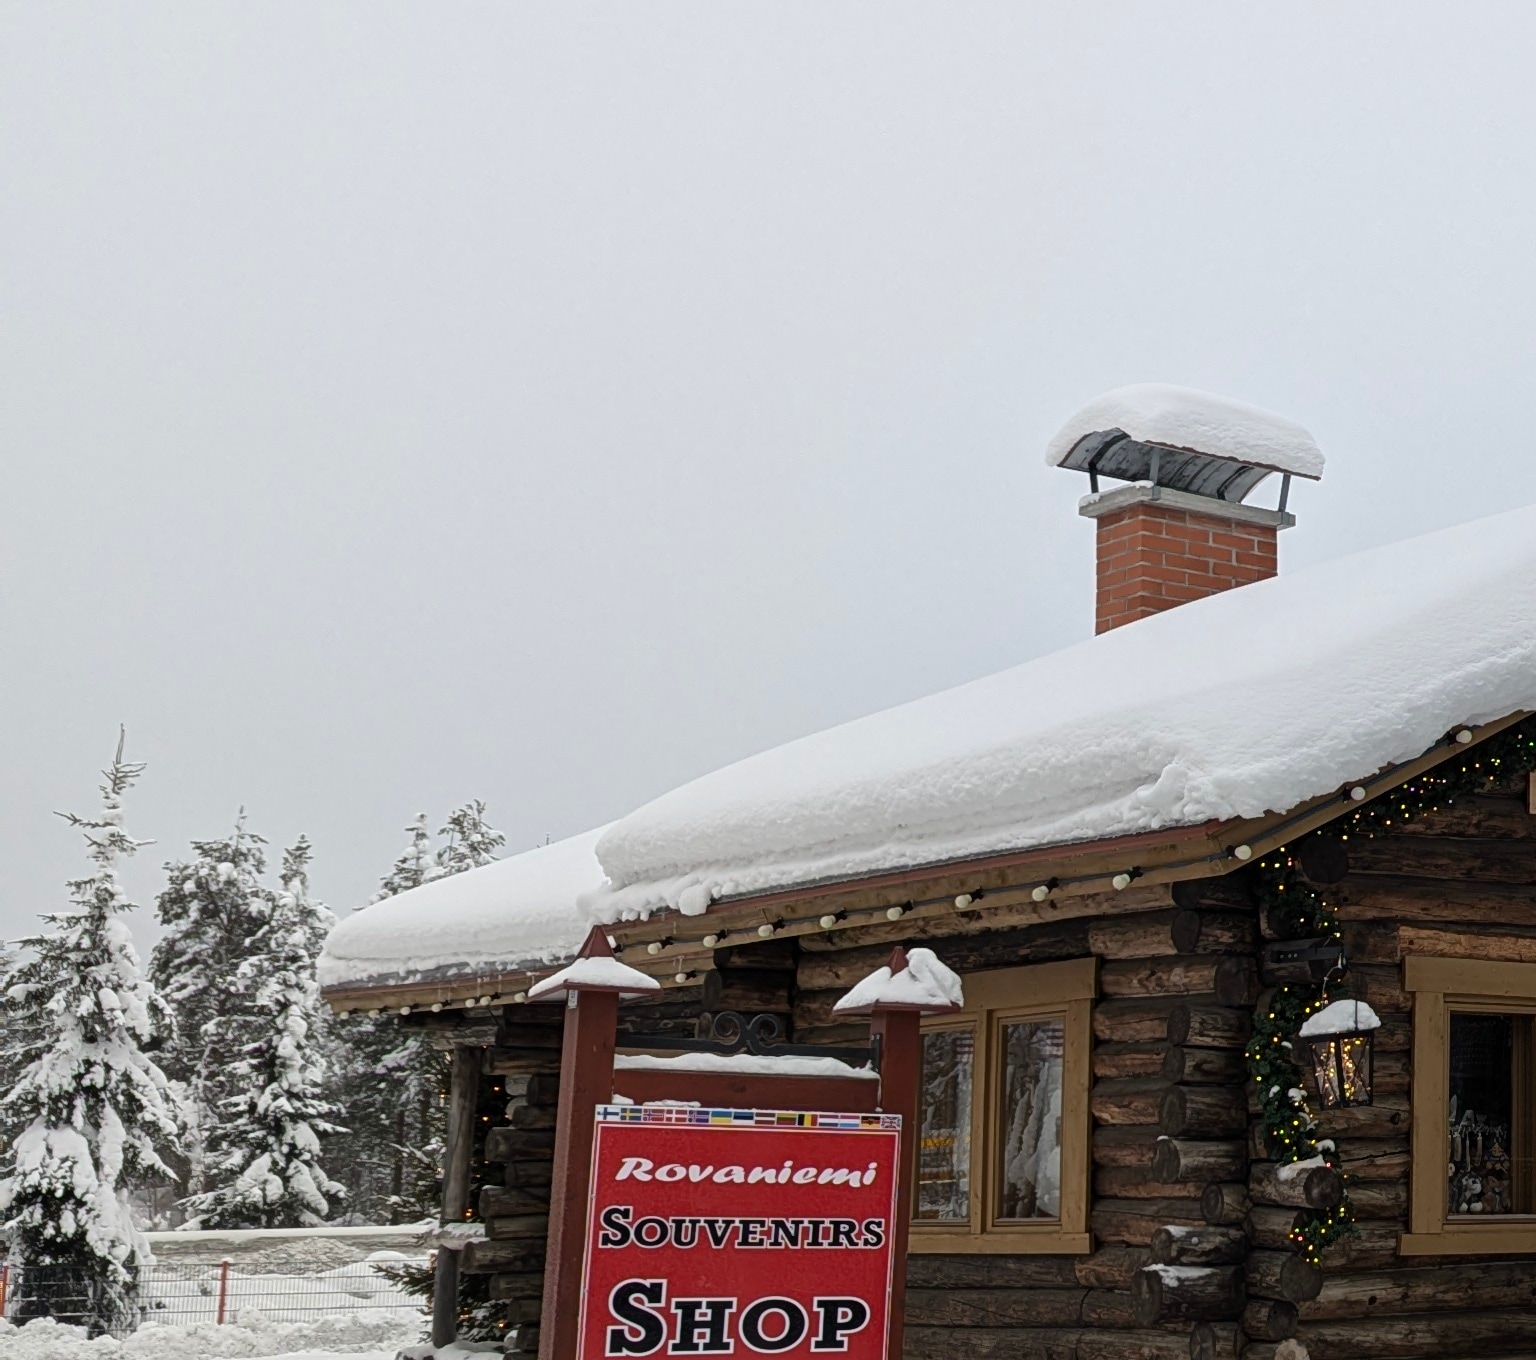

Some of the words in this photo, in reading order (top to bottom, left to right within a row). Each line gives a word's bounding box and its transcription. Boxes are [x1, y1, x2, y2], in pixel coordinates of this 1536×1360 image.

[614, 1157, 878, 1188] Rovaniemi
[598, 1205, 886, 1249] SOUVENIRS
[604, 1278, 871, 1357] SHOP
